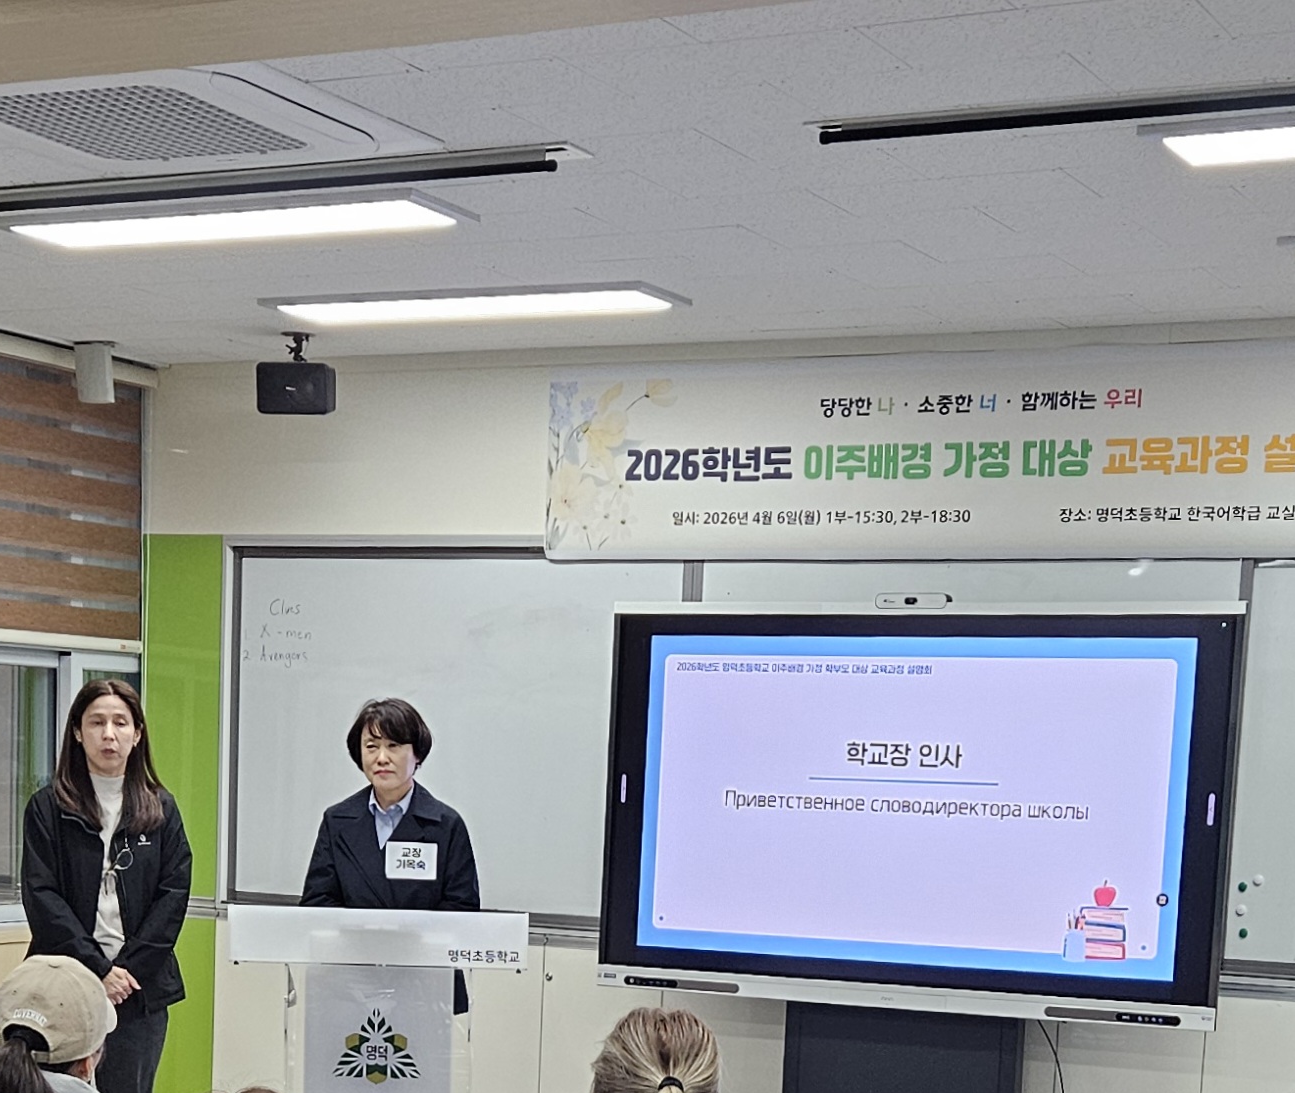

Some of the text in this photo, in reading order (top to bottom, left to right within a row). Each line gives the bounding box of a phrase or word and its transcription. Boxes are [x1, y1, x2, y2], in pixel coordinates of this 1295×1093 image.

[819, 396, 872, 418] 당당한
[877, 396, 895, 416] 나
[917, 394, 973, 415] 소중한
[979, 393, 997, 412] 너
[1021, 390, 1098, 411] 함께하는
[1104, 388, 1143, 409] 우리
[624, 446, 793, 483] 2026학년도
[803, 442, 932, 481] 이주배경
[943, 439, 1011, 479] 가정
[1021, 438, 1093, 478] 대상
[1102, 433, 1250, 476] 교육과정
[672, 508, 972, 527] 일시: 2026년 4월 6일(월) 1부-15:30, 2부-18:30
[1059, 507, 1092, 523] 장소:
[1096, 506, 1182, 523] 명덕초등학교
[1187, 505, 1262, 522] 한국어학급
[676, 662, 720, 672] 2026학년도
[846, 742, 963, 769] 학교장 인사
[724, 789, 1090, 821] Приветственное словодиректора школы
[401, 847, 422, 858] 교장
[448, 949, 520, 964] 명덕초등학교
[365, 1044, 388, 1061] 명덕
